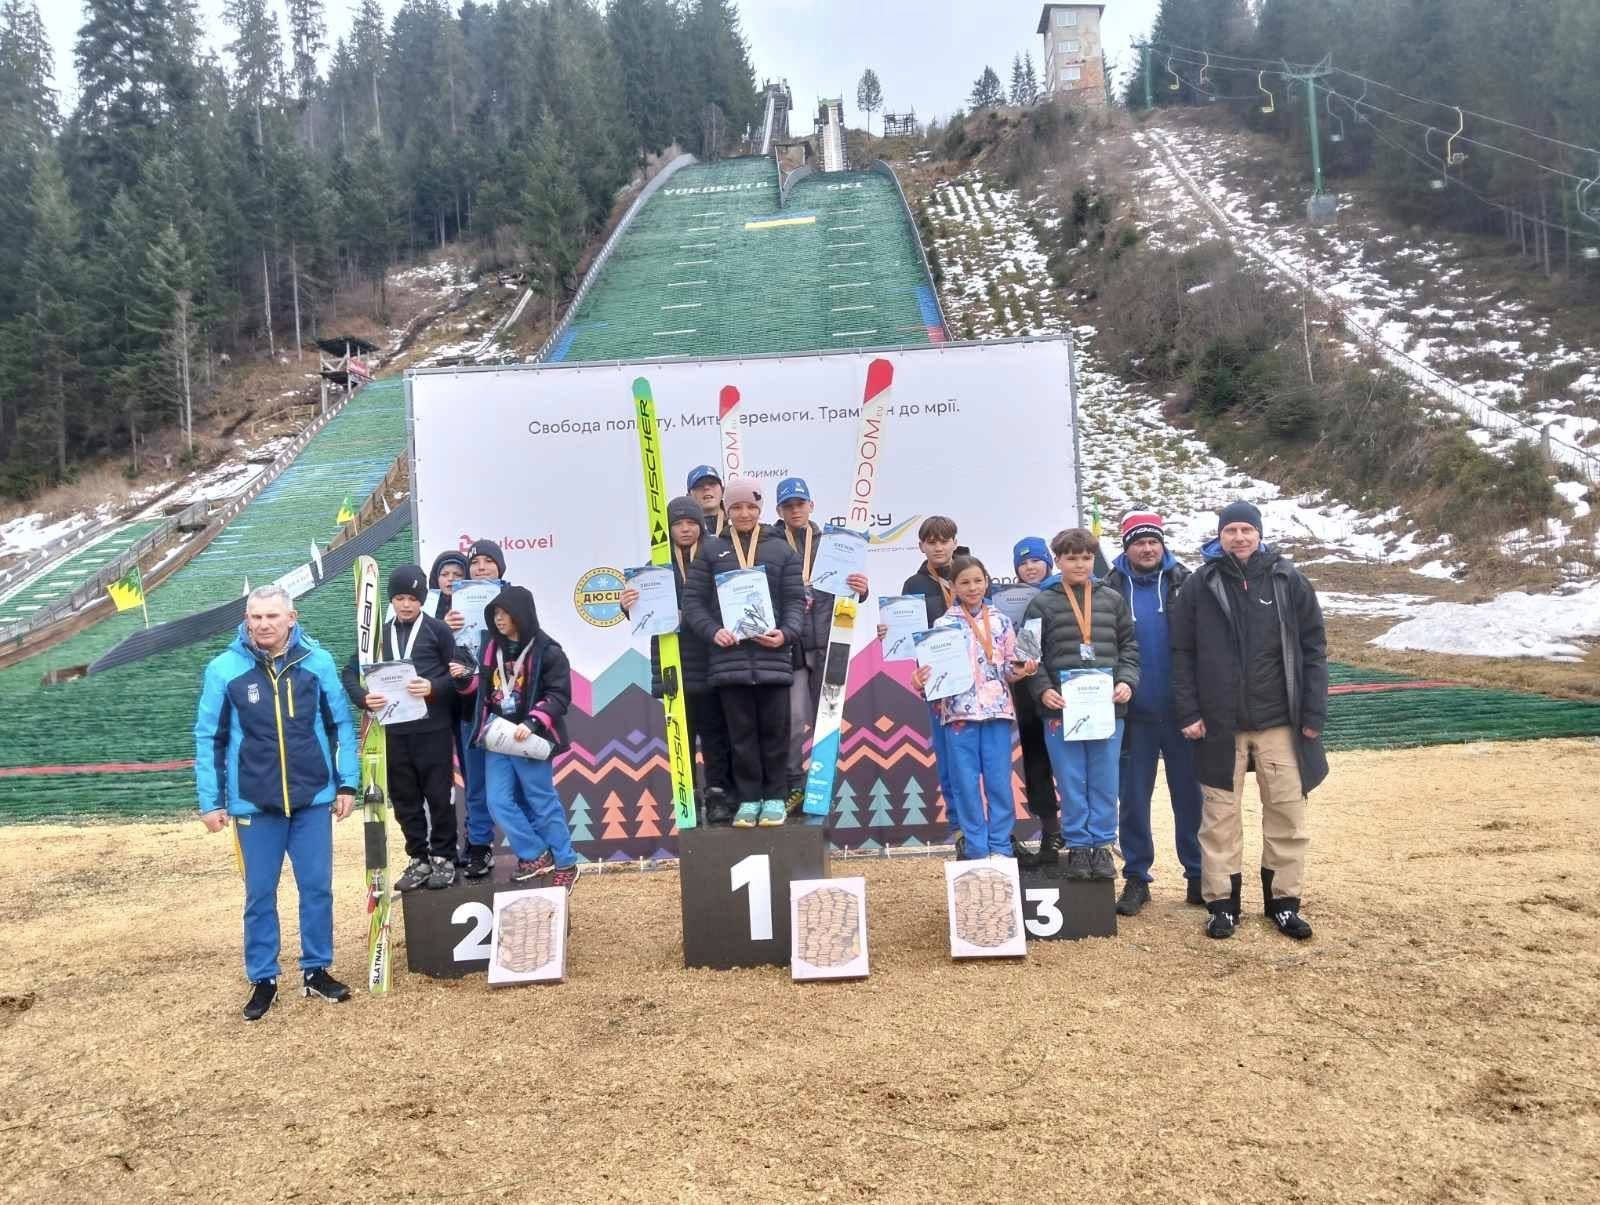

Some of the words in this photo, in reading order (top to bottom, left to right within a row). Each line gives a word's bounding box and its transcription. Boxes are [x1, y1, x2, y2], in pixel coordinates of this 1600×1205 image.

[529, 420, 601, 435] Свобода
[606, 417, 676, 431] полту.
[739, 410, 814, 427] еремоги.
[899, 404, 920, 416] до
[924, 398, 960, 417] мрії.
[640, 399, 661, 514] FISCHER
[360, 583, 374, 653] elan
[672, 719, 689, 819] FISCHER
[730, 854, 773, 941] 1
[1025, 887, 1064, 937] 3
[372, 943, 383, 984] SLATNAR
[450, 901, 493, 962] 2
